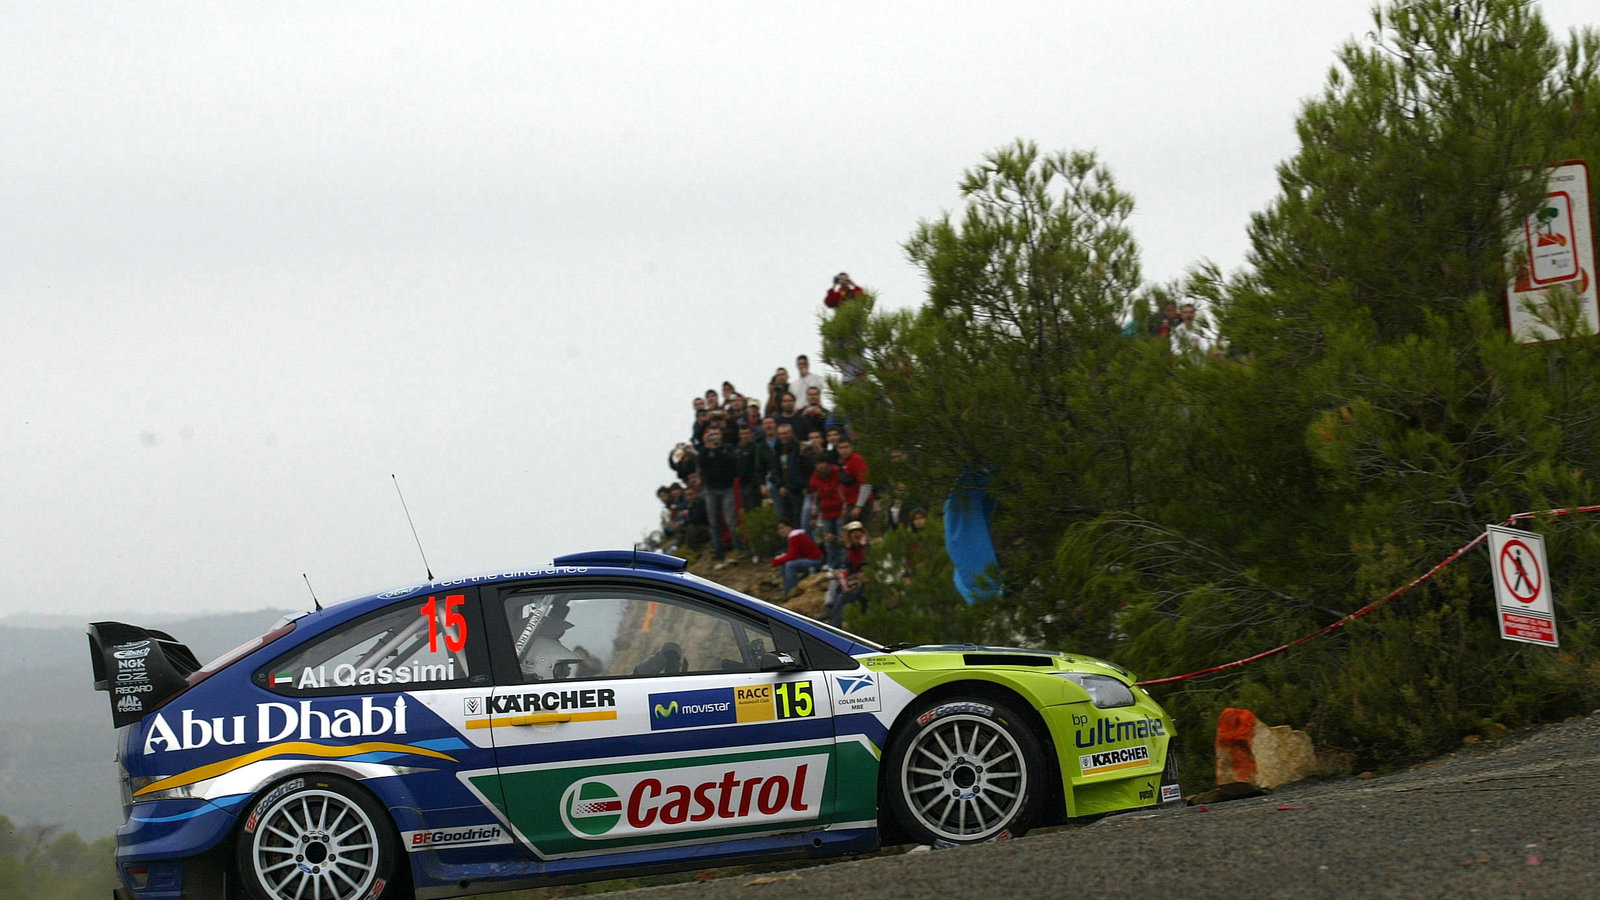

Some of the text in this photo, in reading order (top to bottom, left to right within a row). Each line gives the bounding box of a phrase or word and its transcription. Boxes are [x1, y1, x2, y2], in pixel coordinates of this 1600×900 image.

[420, 594, 468, 653] 15
[118, 658, 146, 669] NGK
[297, 658, 455, 690] Al Qassimi
[115, 684, 153, 695] RECARO
[737, 687, 770, 700] RACC
[776, 681, 813, 718] 15
[485, 688, 616, 715] KÄRCHER
[682, 701, 731, 715] movistar
[838, 696, 876, 706] COLIN McRAE
[143, 695, 408, 755] Abu Dhabi
[1071, 714, 1088, 727] bp
[1075, 714, 1166, 749] ultimate
[1091, 746, 1149, 767] KÄRCHER
[626, 763, 809, 829] Castrol
[411, 826, 501, 845] BFGoodrich
